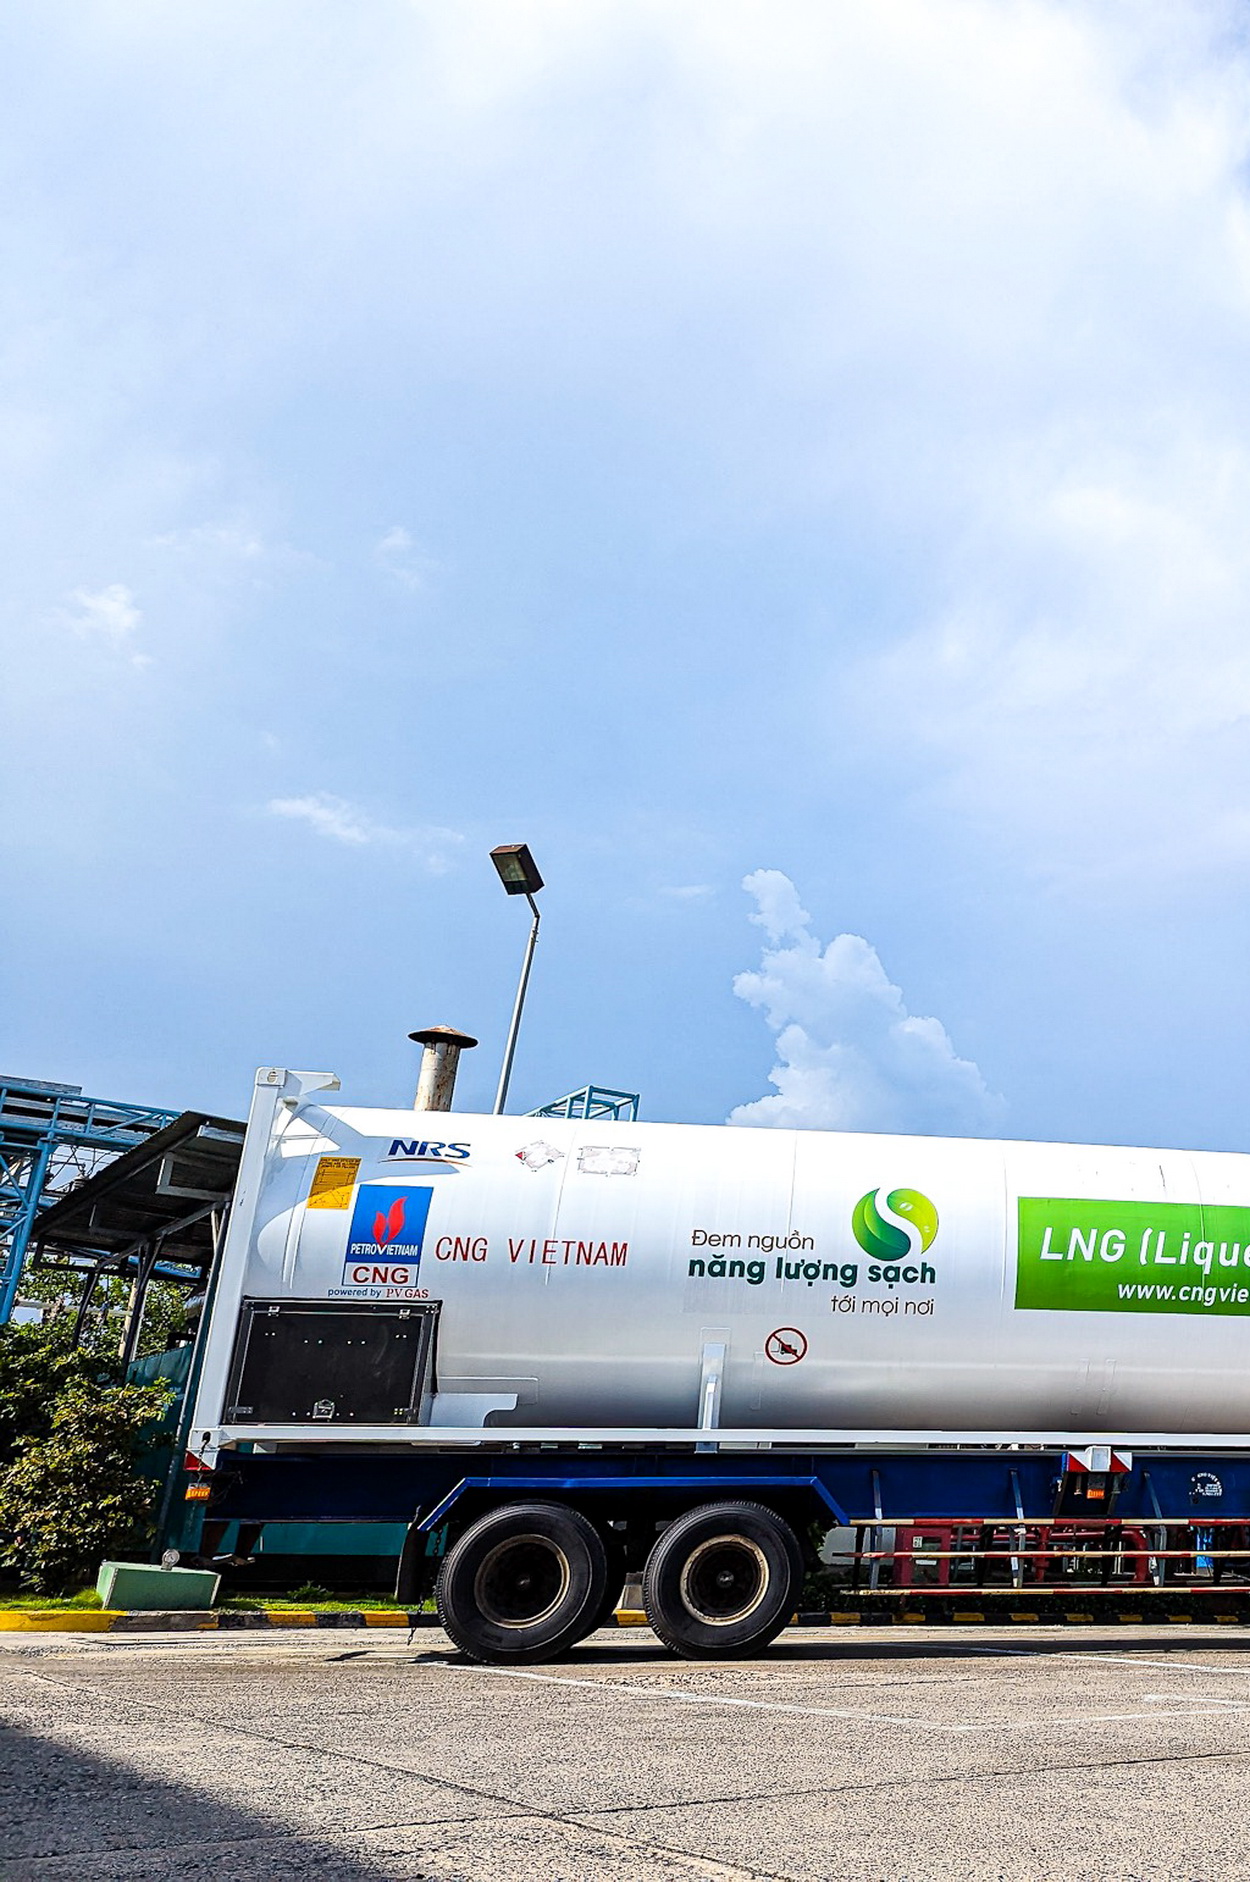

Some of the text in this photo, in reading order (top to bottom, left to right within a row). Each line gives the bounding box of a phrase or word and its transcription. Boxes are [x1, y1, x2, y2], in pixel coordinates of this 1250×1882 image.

[387, 1139, 471, 1159] NRS
[435, 1236, 628, 1267] CNG VIETNAM
[692, 1229, 814, 1252] Đem nguồn
[1039, 1226, 1126, 1263] LNG
[352, 1266, 409, 1285] CNG
[688, 1254, 936, 1289] năng lượng sạch
[328, 1288, 368, 1297] powered
[370, 1288, 381, 1298] by
[831, 1295, 935, 1317] tới mọi nơi
